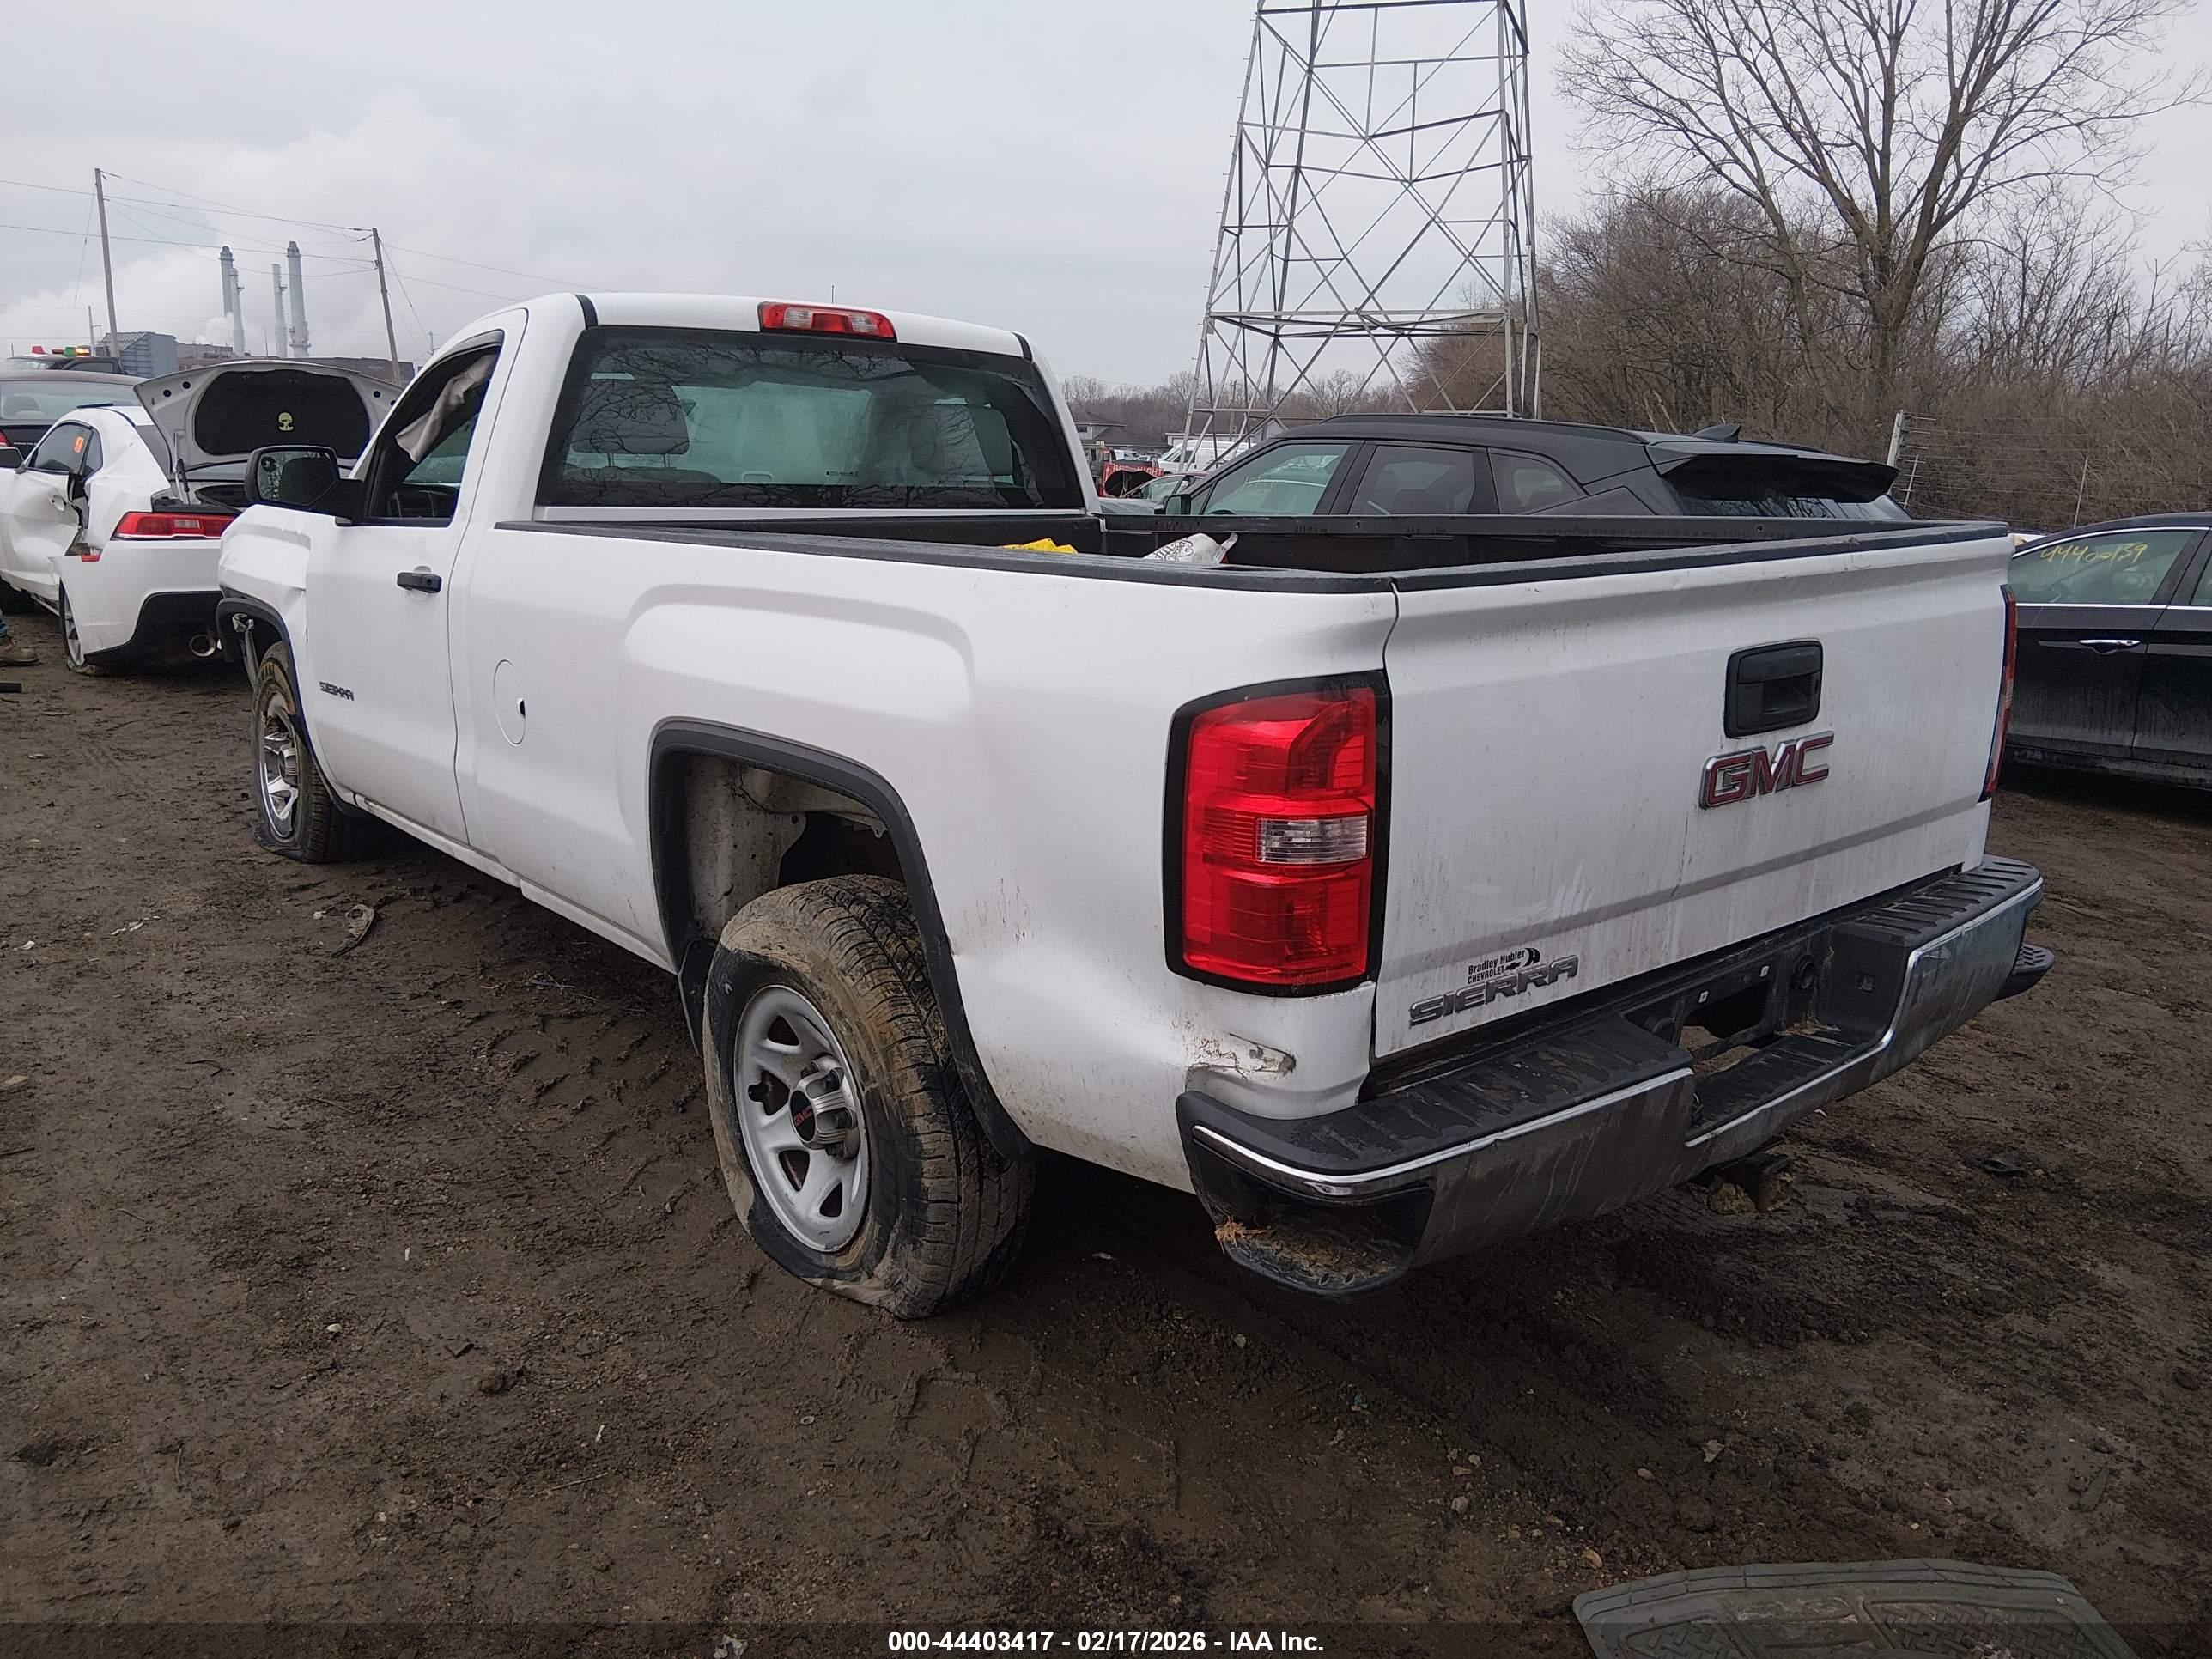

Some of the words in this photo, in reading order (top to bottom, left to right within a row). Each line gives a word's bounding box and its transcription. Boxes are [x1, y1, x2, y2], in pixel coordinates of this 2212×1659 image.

[1699, 731, 1834, 810] GMC
[1468, 958, 1498, 975] Bradley
[1500, 950, 1525, 963] Hubler
[1468, 965, 1504, 984] CHEVROLET
[1408, 954, 1578, 1028] SIERRA
